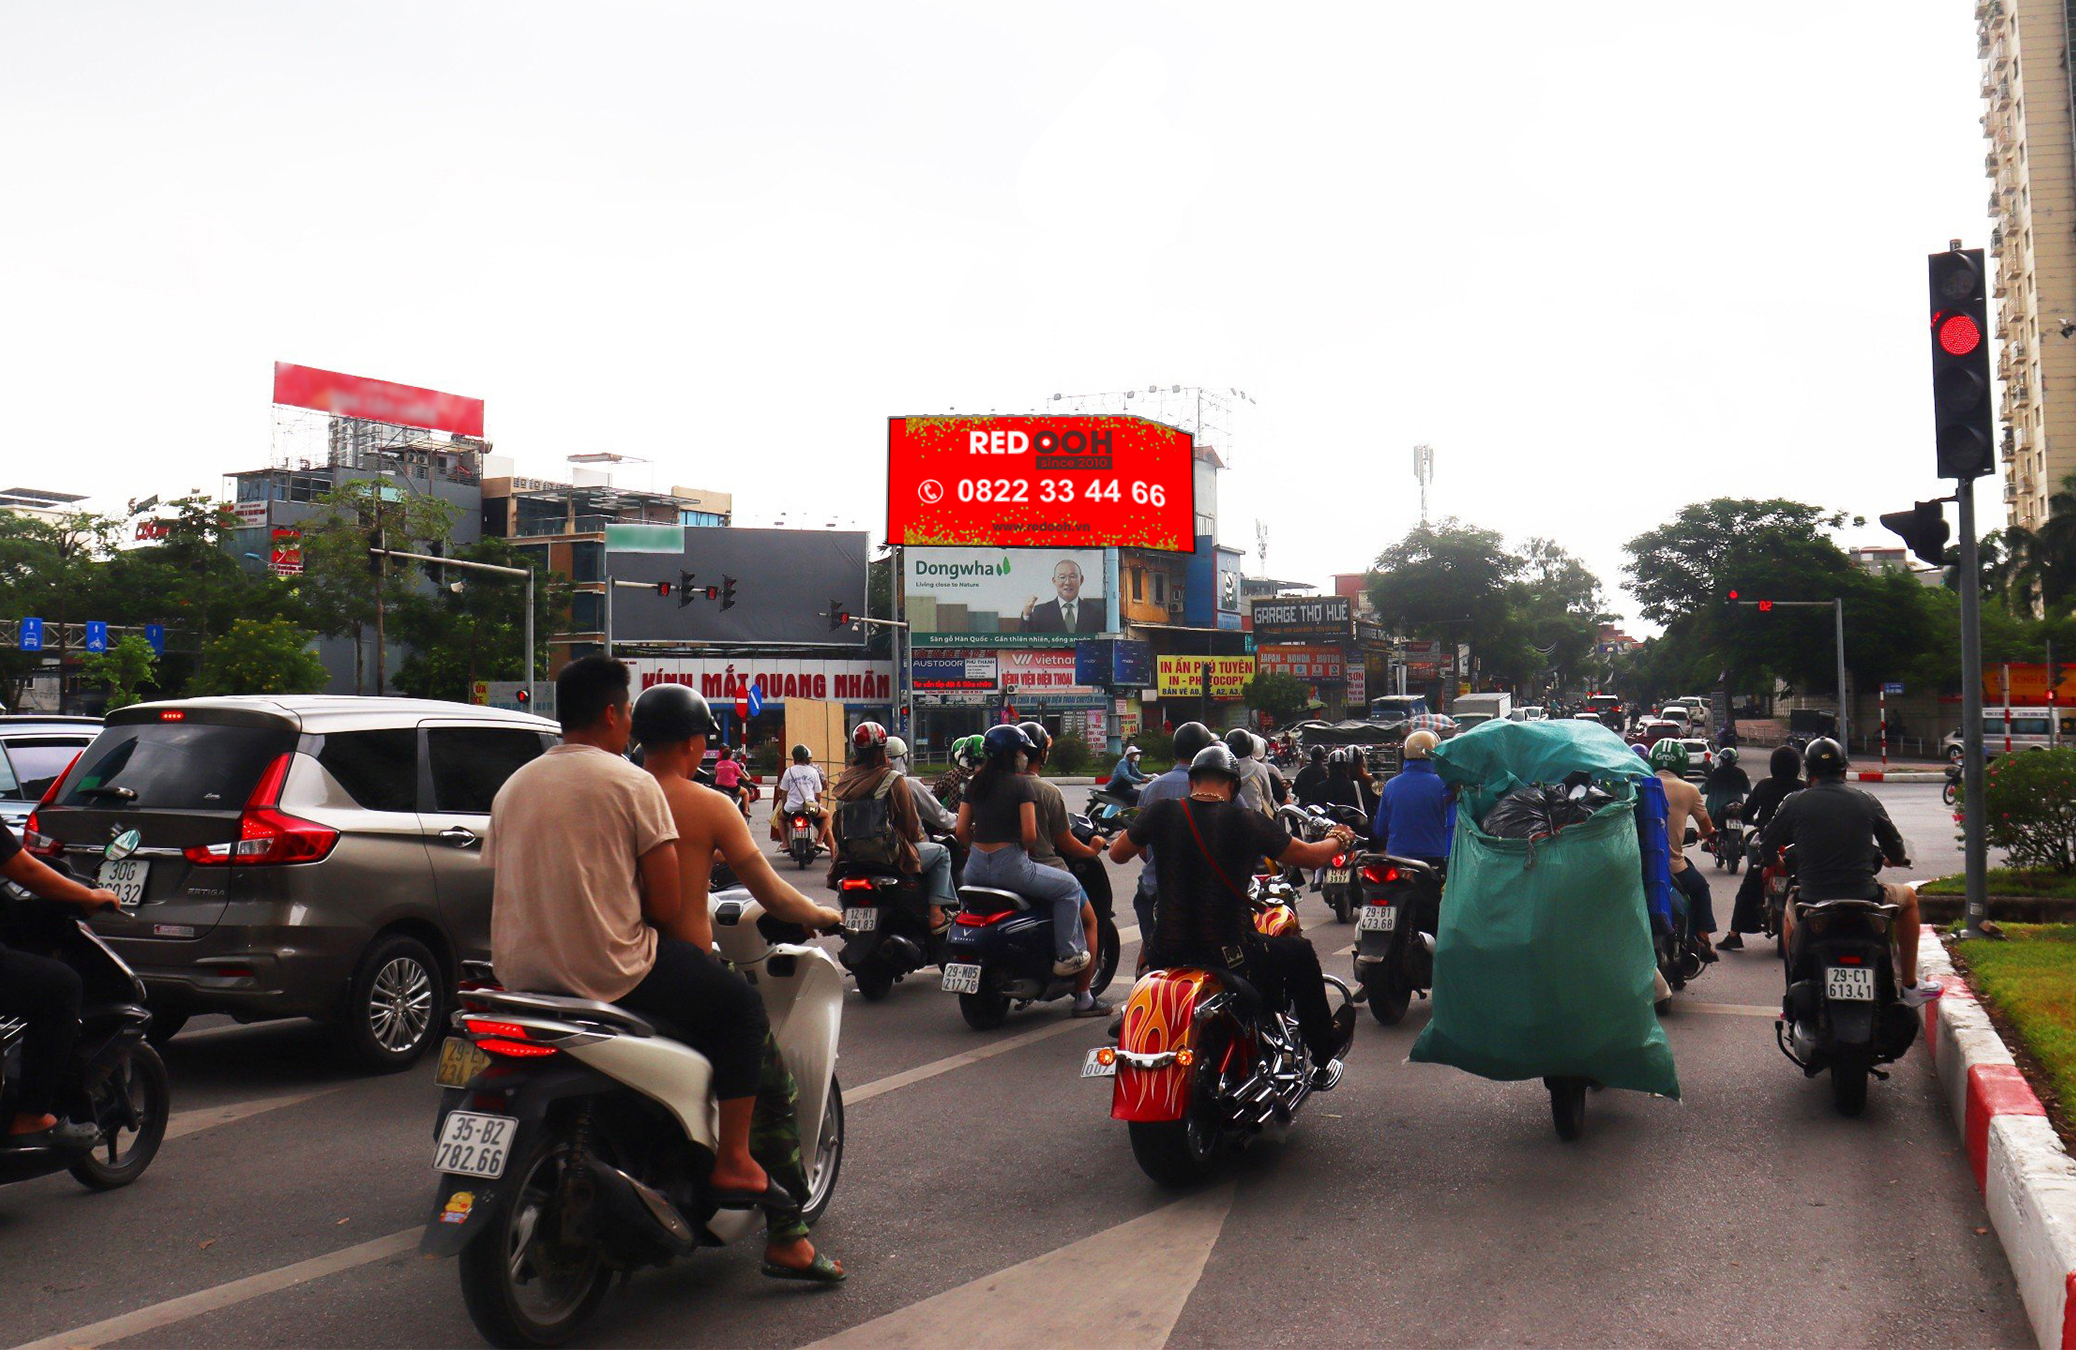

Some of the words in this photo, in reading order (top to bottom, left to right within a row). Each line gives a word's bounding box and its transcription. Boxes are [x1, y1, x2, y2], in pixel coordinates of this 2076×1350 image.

[970, 431, 1029, 454] RED
[1033, 430, 1112, 454] OOH
[1041, 458, 1075, 467] since
[1078, 458, 1108, 467] 2010
[958, 479, 1029, 502] 0822
[1040, 479, 1075, 502] 33
[1085, 479, 1121, 502] 44
[1131, 481, 1166, 507] 66
[992, 522, 1091, 532] www.redooh.vn
[916, 560, 994, 579] Dongwha
[1254, 606, 1297, 624] GARAGE
[1300, 604, 1322, 624] THỢ
[1326, 600, 1348, 621] HUẾ
[1759, 601, 1773, 611] 02
[944, 634, 953, 643] gỗ
[1052, 635, 1068, 643] sống
[1160, 662, 1172, 673] IN
[1175, 657, 1191, 673] ẤN
[1194, 659, 1215, 673] PÚ
[1219, 659, 1253, 673] TUYÊN
[1260, 654, 1280, 663] JAPAN
[1287, 654, 1310, 663] HONDA
[1316, 654, 1340, 663] MOTOR
[755, 673, 826, 698] QUANG
[834, 670, 890, 698] NHÃN
[1020, 670, 1036, 687] VIỆN
[1037, 670, 1052, 687] ĐIỆN
[1054, 672, 1073, 687] THOẠI
[1169, 676, 1179, 685] IN
[1162, 686, 1177, 695] BẢN
[1179, 687, 1187, 695] VẼ
[1216, 688, 1228, 696] A2,
[1656, 752, 1677, 762] Grab
[109, 861, 137, 881] 30G
[187, 888, 225, 896] ERTIGA
[1365, 907, 1391, 918] 29-B1
[1361, 918, 1393, 929] 473.68
[1833, 969, 1867, 983] 29-C1
[1829, 984, 1871, 998] 613.41
[452, 1116, 506, 1145] 35-B2
[437, 1143, 502, 1174] 782.66
